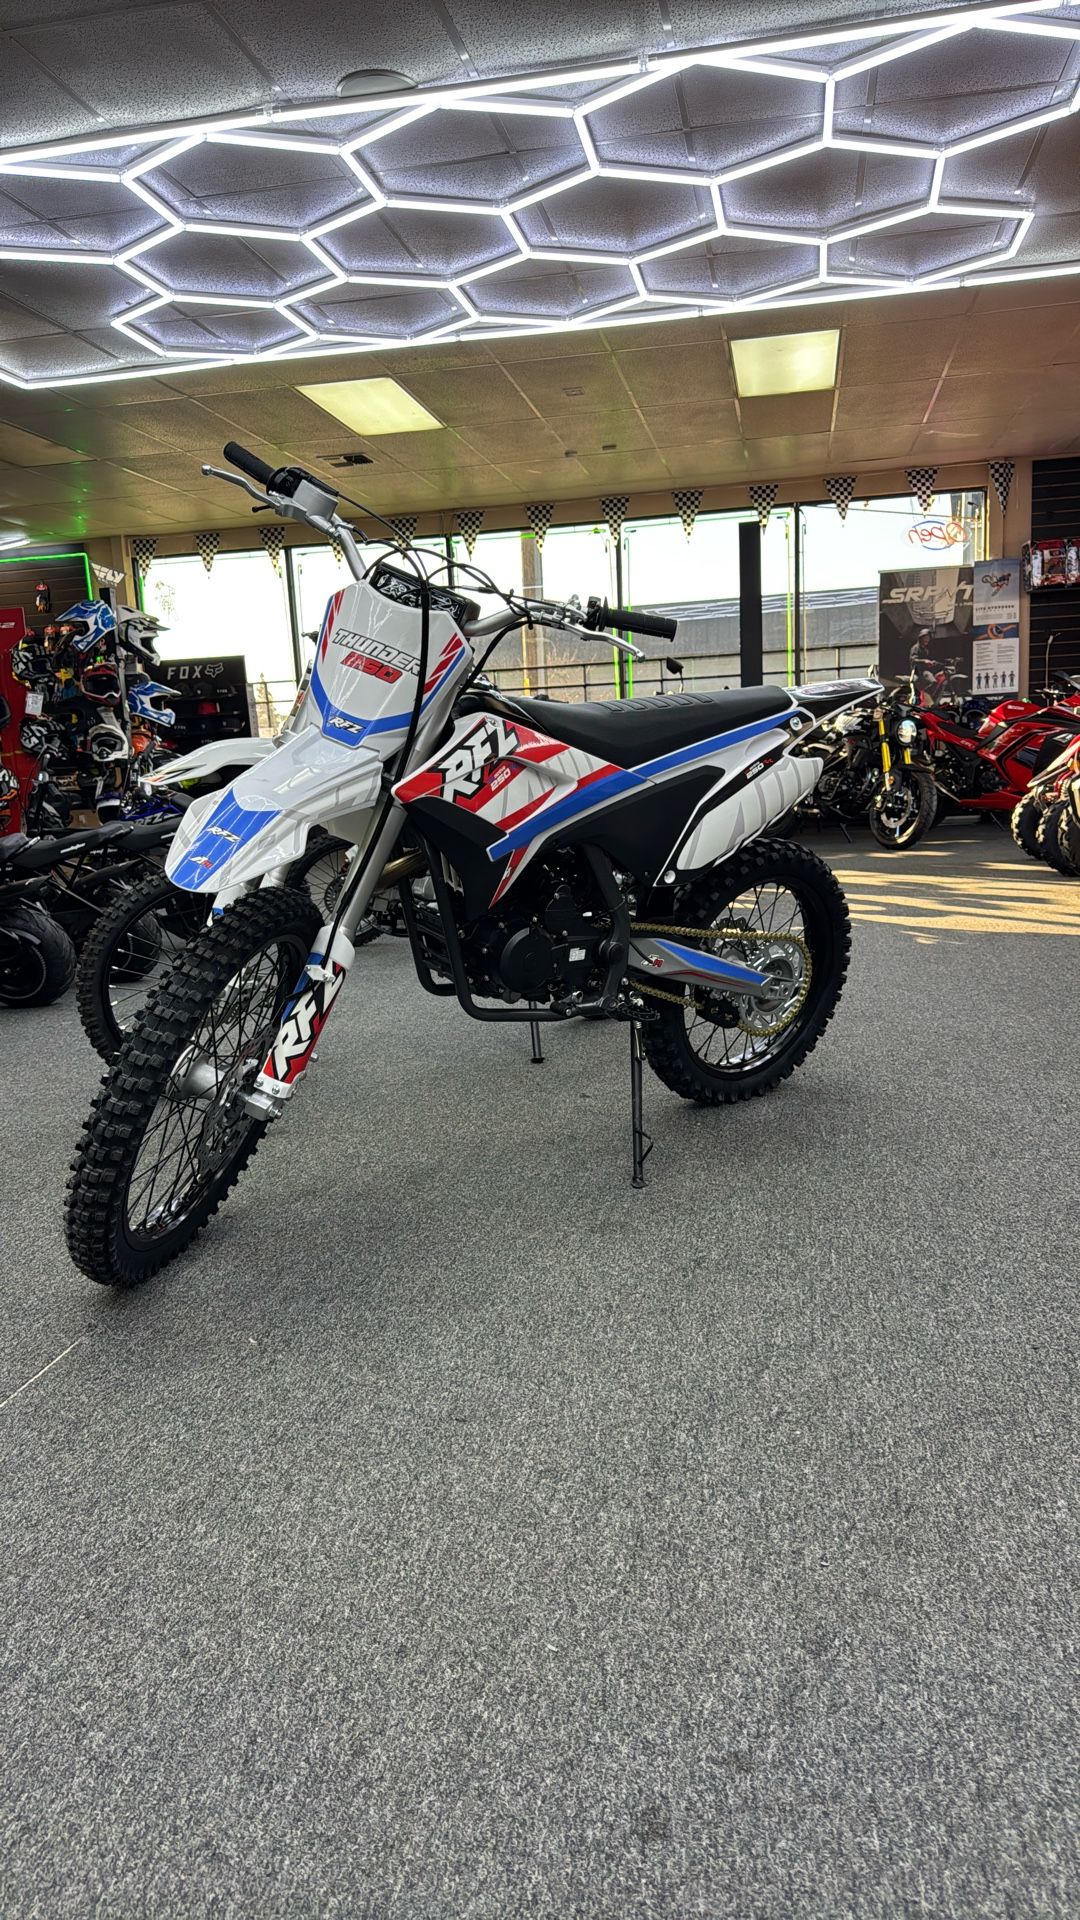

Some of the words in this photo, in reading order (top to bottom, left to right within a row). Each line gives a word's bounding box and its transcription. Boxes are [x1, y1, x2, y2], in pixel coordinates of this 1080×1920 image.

[167, 665, 203, 680] FOX
[328, 716, 366, 734] RFZ
[437, 720, 519, 802] RFZ
[490, 768, 511, 791] 250
